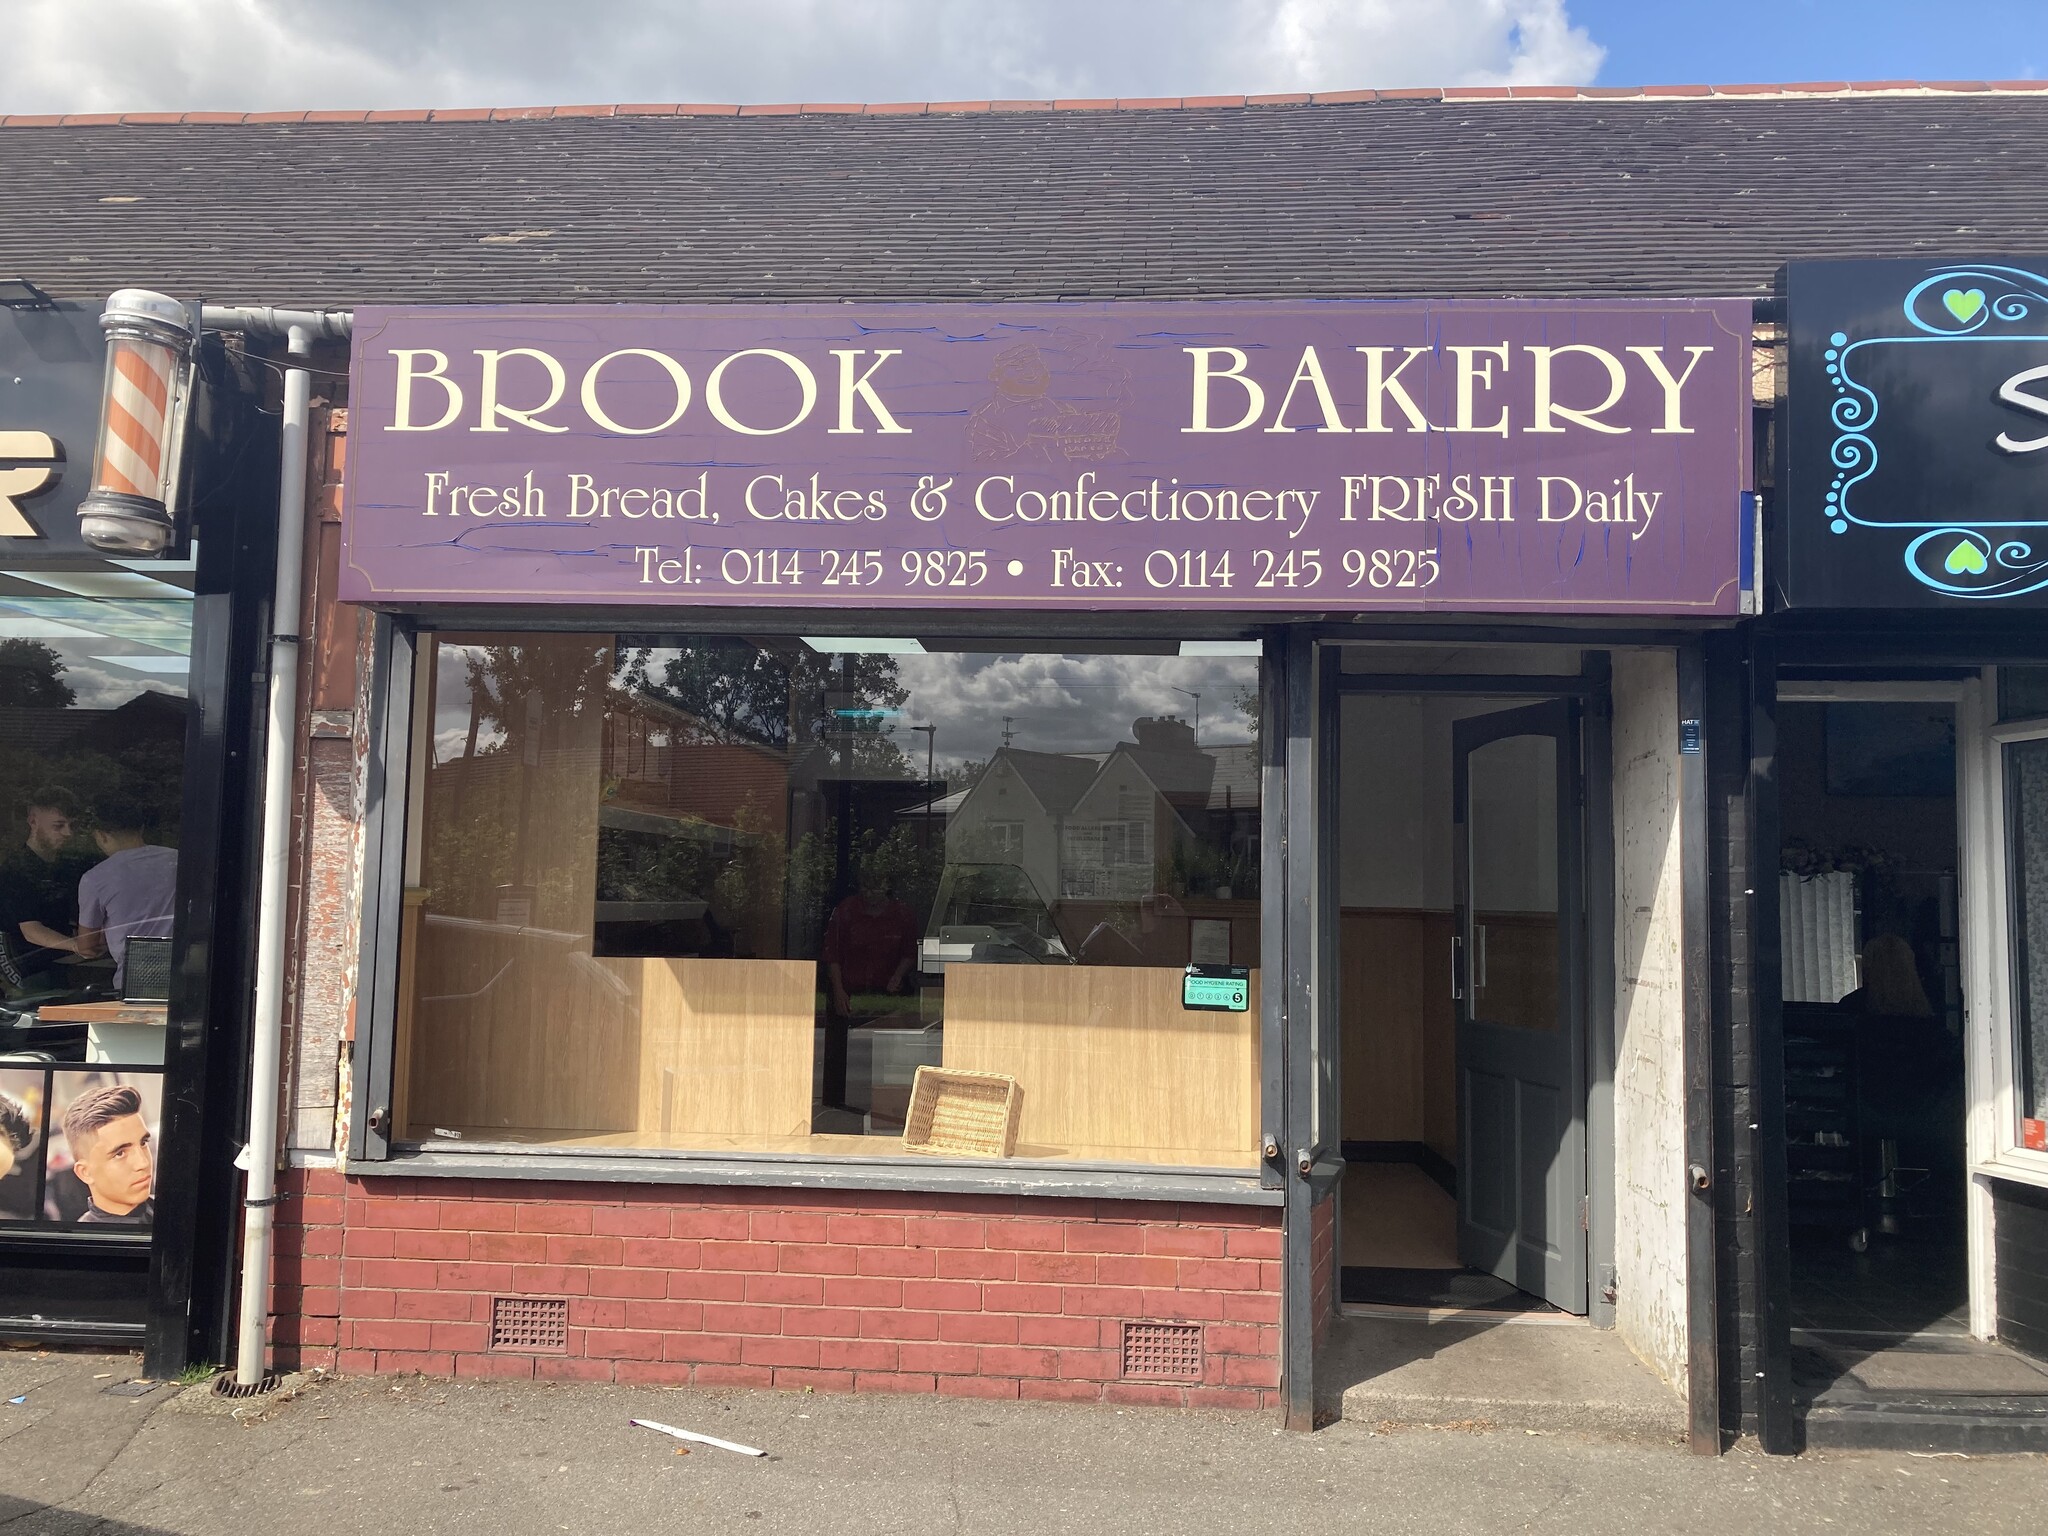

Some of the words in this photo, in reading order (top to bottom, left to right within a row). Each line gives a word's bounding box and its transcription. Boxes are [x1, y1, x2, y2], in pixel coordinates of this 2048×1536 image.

[383, 347, 913, 436] BROOK
[1180, 340, 1715, 439] BAKERY
[422, 469, 547, 518] Fresh
[566, 470, 720, 525] Bread,
[745, 471, 887, 521] Cakes
[910, 475, 953, 522] &
[974, 471, 1321, 539] Confectionery
[1339, 473, 1515, 523] FRESH
[1536, 472, 1663, 541] Daily
[635, 546, 702, 585] Tel:
[721, 548, 804, 586] 0114
[820, 549, 883, 586] 245
[901, 549, 988, 587] 9825
[1050, 547, 1123, 588] Fax:
[1144, 549, 1236, 589] 0114
[1253, 548, 1322, 588] 245
[1342, 547, 1440, 589] 9825
[1234, 993, 1241, 1002] 5
